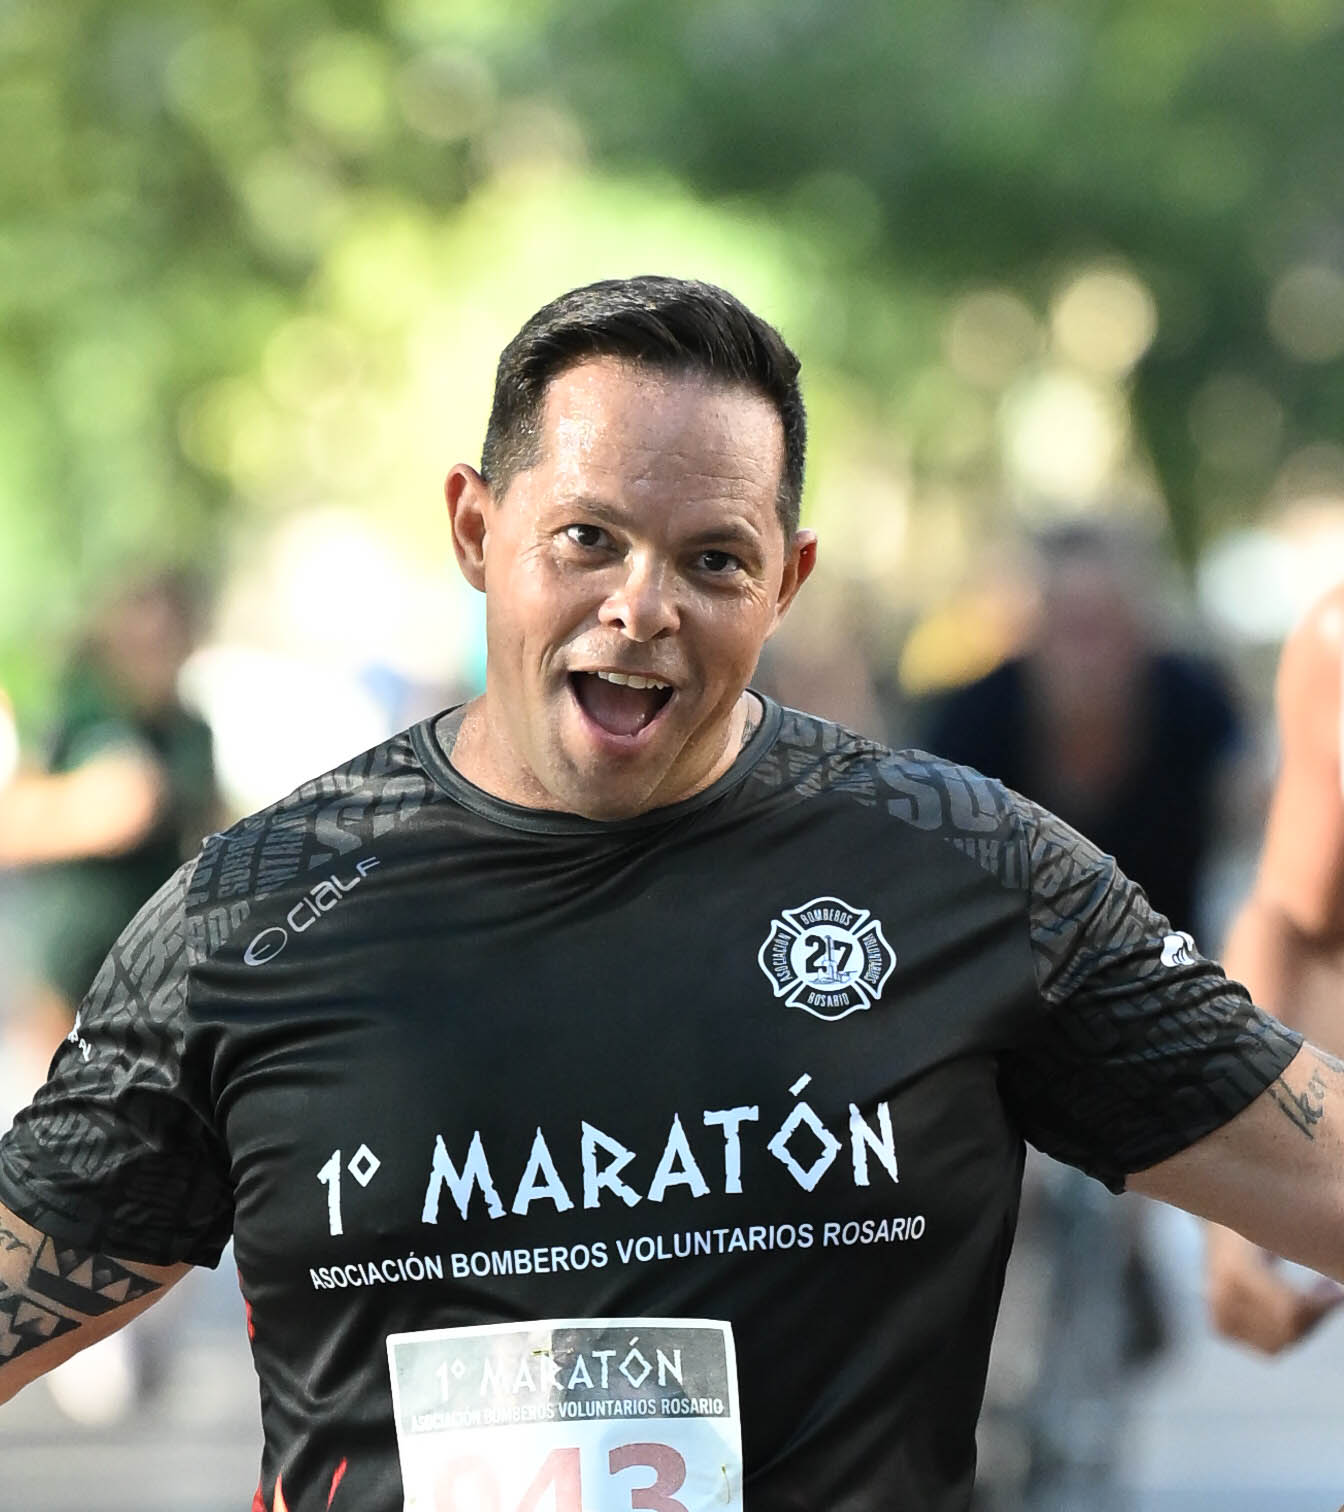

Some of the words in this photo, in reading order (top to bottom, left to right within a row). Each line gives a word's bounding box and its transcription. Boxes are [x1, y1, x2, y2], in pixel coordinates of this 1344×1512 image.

[800, 908, 853, 926] BOMBEROS
[804, 934, 854, 974] 27
[807, 991, 850, 1007] ROSARIO
[421, 1073, 899, 1224] MARATÓN
[309, 1251, 444, 1290] ASOCIACIÓN
[451, 1242, 609, 1278] BOMBEROS
[616, 1223, 814, 1264] VOLUNTARIOS
[823, 1215, 926, 1247] ROSARIO
[480, 1336, 683, 1396] MARATÓN
[558, 1398, 656, 1418] VOLUNTARIOS
[661, 1397, 723, 1416] ROSARIO
